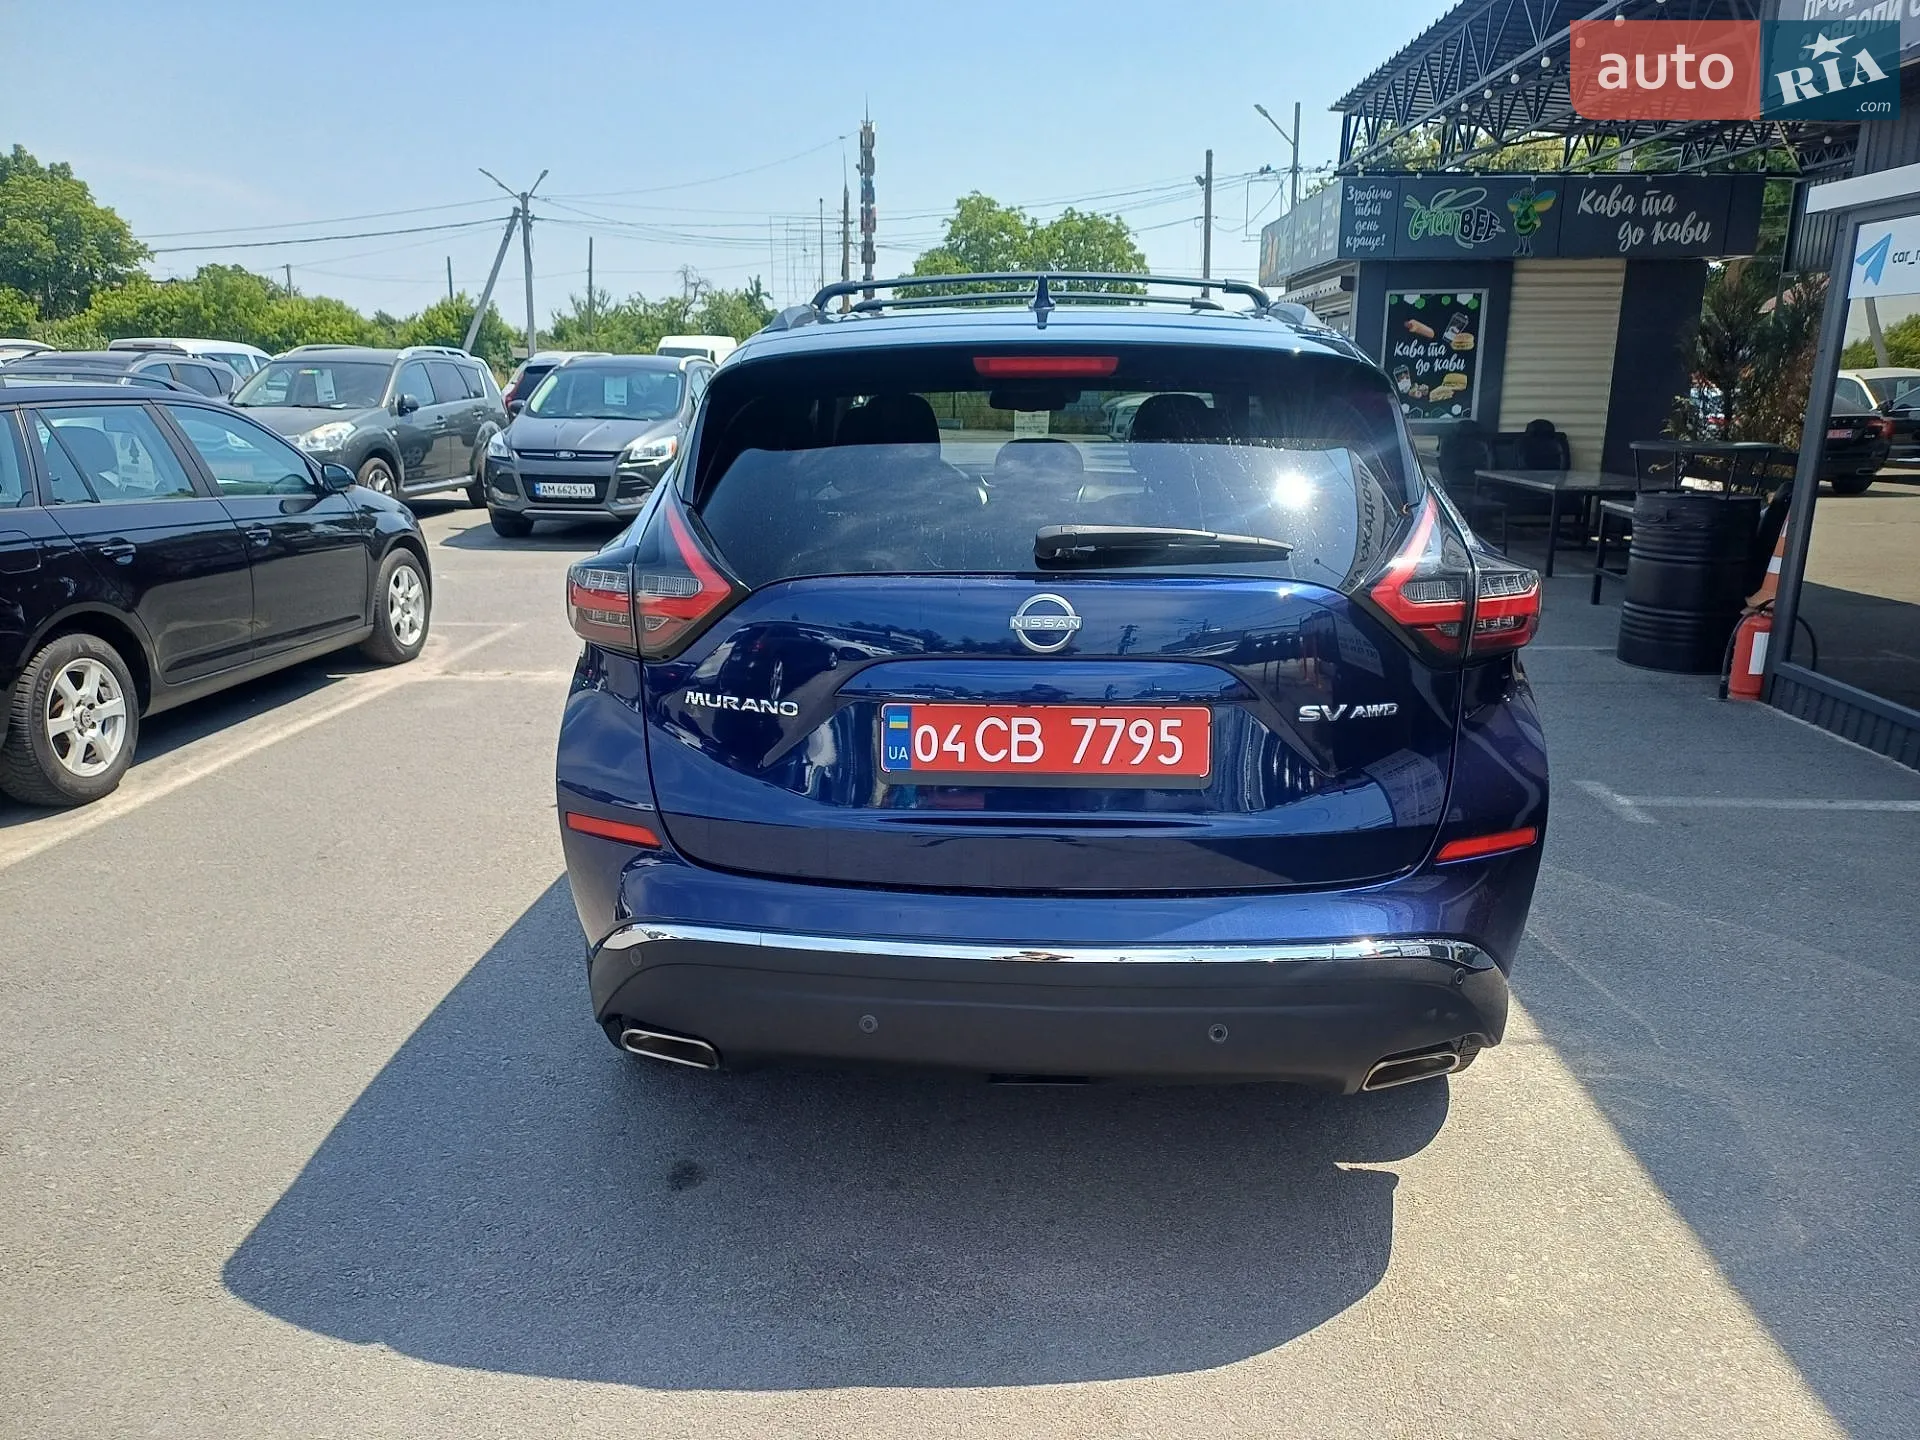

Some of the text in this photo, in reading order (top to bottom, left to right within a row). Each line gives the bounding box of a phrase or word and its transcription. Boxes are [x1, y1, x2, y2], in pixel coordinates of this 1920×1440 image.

[1577, 183, 1677, 218] Кава та
[1355, 220, 1379, 236] день
[1618, 211, 1712, 252] до кави
[1345, 233, 1386, 252] краще!
[1394, 339, 1448, 358] Кава та
[1415, 353, 1466, 376] до кави
[1012, 618, 1080, 629] NISSAN
[684, 690, 799, 716] MURANO
[1298, 702, 1399, 722] SV AWD
[1070, 718, 1183, 765] 7795
[888, 745, 909, 760] UA
